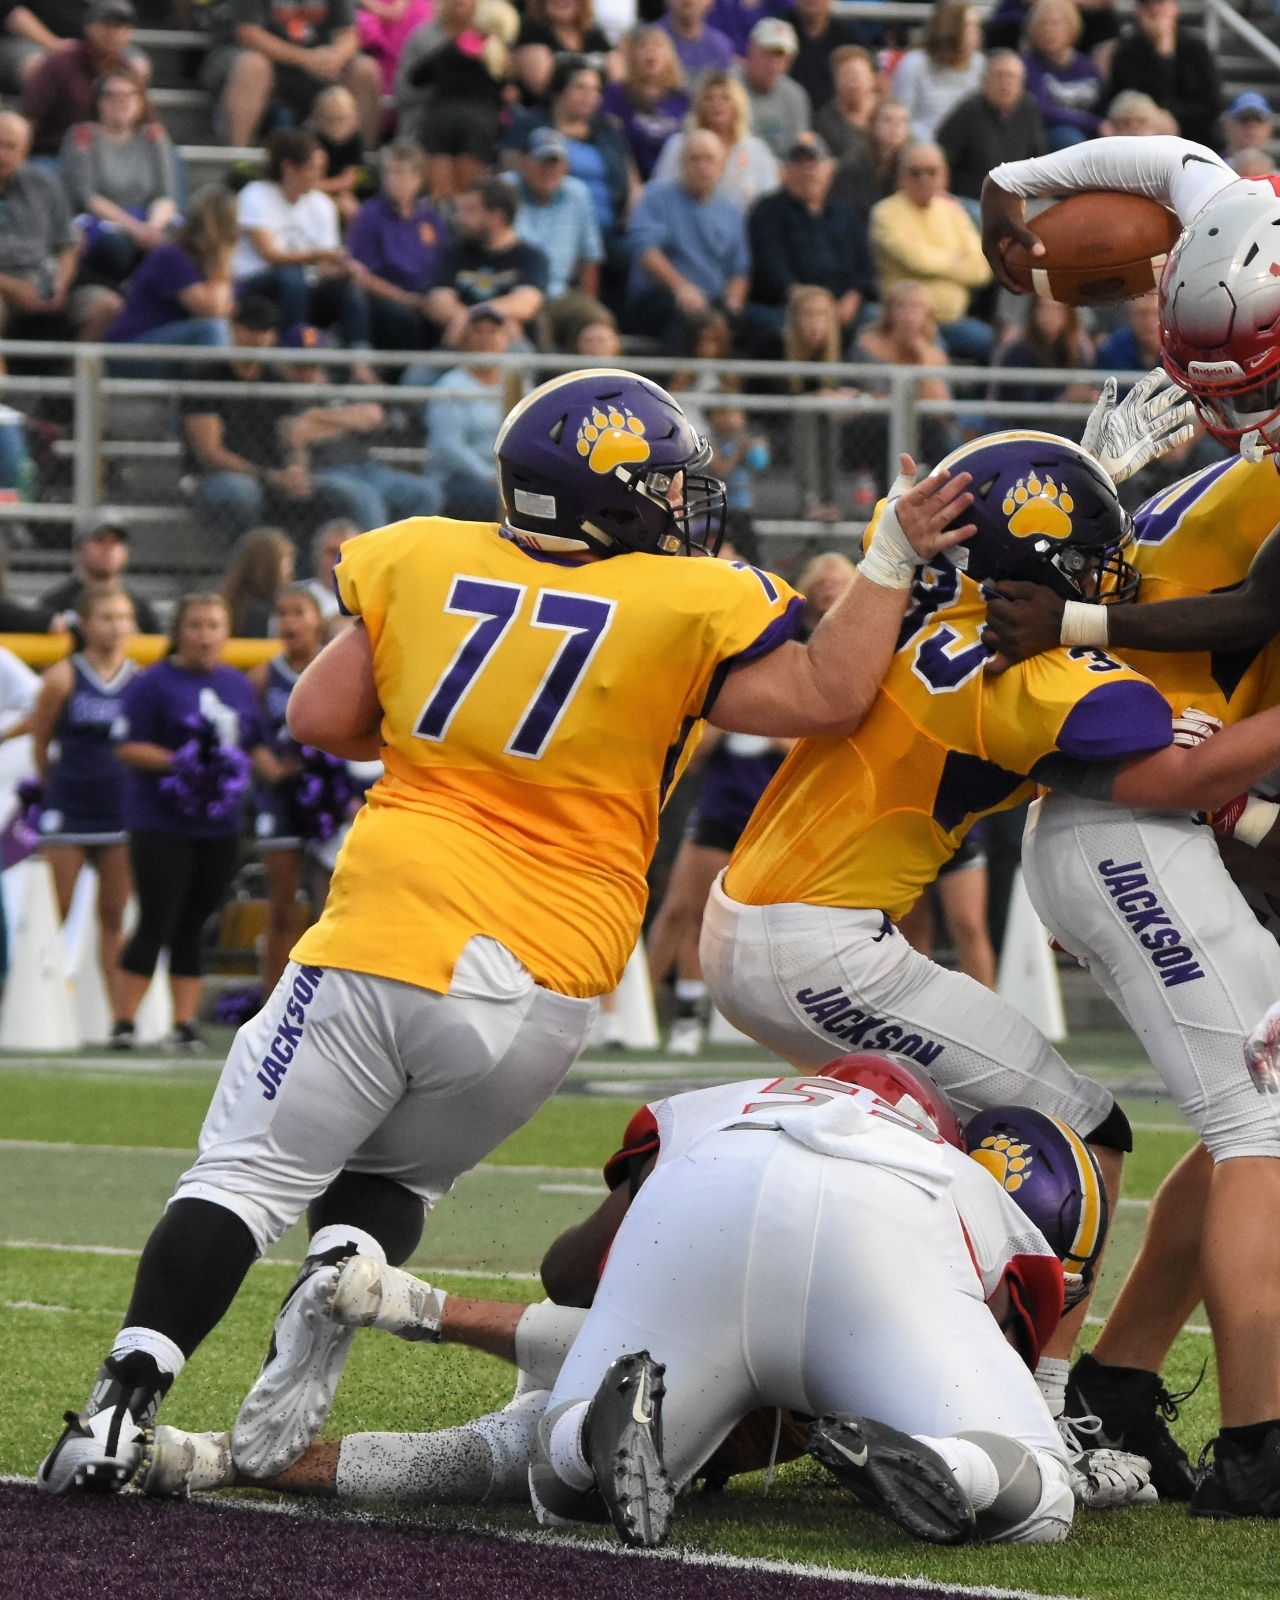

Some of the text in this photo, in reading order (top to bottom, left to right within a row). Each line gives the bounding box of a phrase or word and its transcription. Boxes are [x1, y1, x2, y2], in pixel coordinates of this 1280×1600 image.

[1191, 366, 1234, 375] Riddell
[411, 573, 619, 760] 77
[1098, 859, 1205, 988] JACKSON
[257, 965, 324, 1101] JACKSON
[796, 986, 946, 1067] JACKSON
